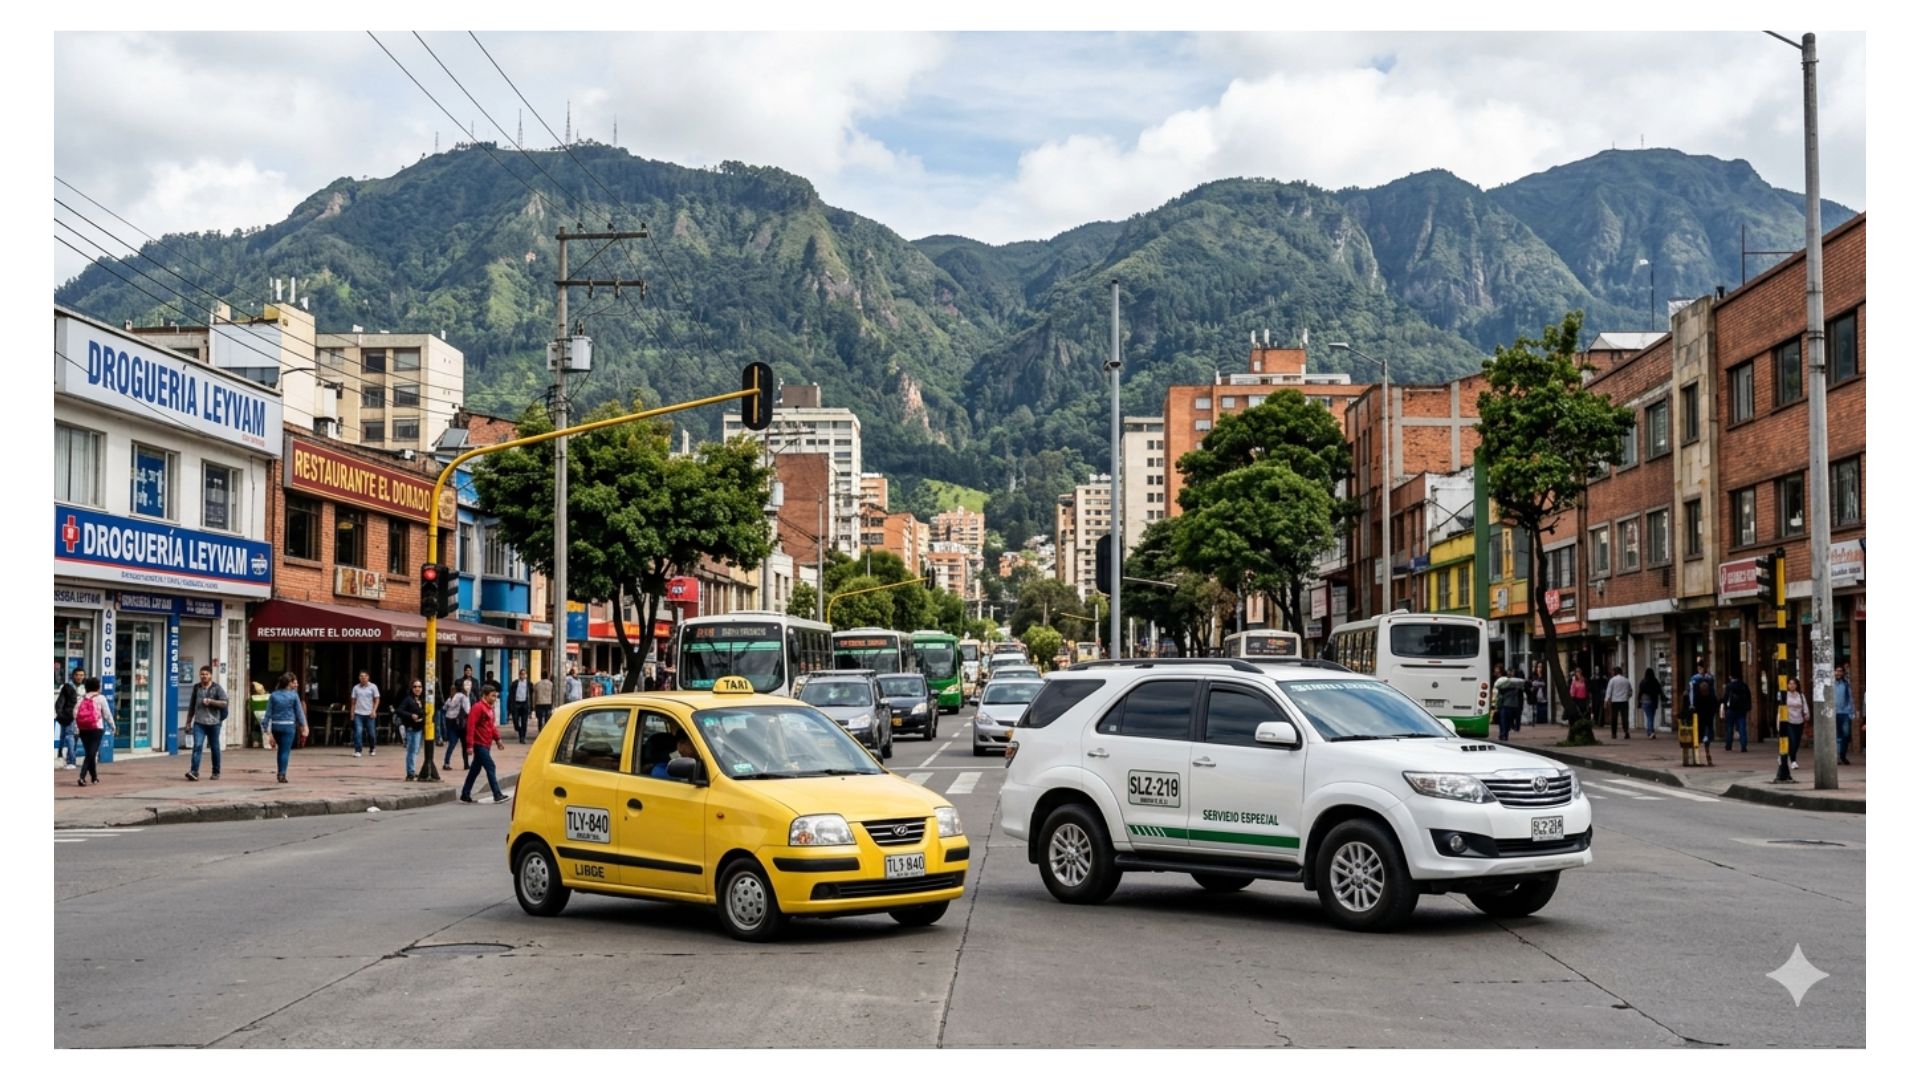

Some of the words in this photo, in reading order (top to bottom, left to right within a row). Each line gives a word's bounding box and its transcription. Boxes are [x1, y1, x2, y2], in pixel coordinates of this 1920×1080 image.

[88, 340, 198, 417] DROGUERÍA
[203, 381, 265, 438] LEYVAM
[295, 449, 377, 497] RESTAURANTE
[379, 475, 391, 503] EL
[83, 522, 185, 569] DROGUERÍA
[189, 539, 247, 576] LEYVAM
[257, 627, 326, 638] RESTAURANTE
[327, 628, 340, 638] EL
[341, 628, 382, 638] DORADO
